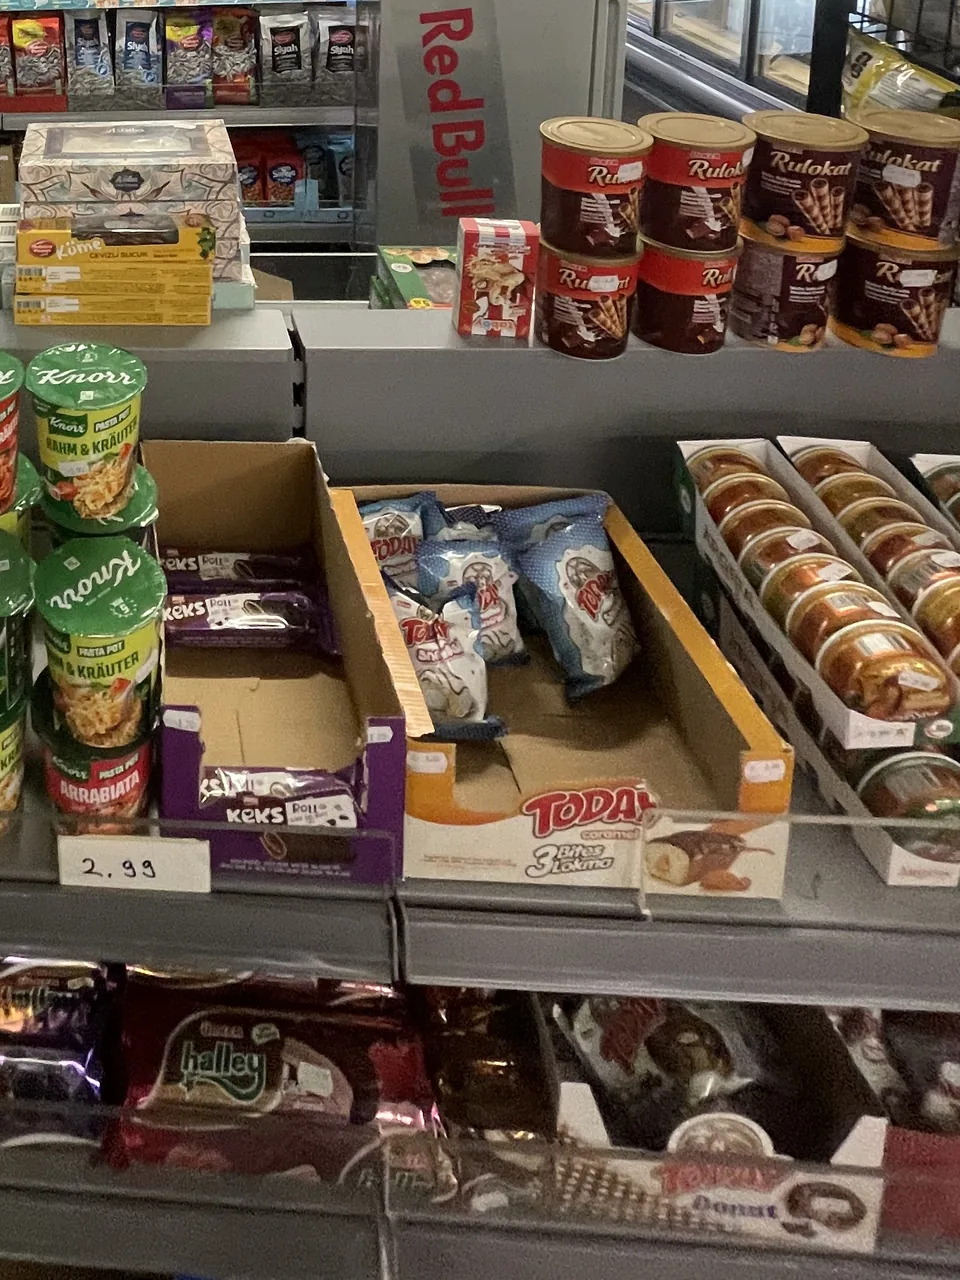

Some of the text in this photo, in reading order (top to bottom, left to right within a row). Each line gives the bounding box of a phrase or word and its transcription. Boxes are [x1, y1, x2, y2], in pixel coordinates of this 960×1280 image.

[274, 43, 299, 55] Siyah
[330, 45, 355, 56] Siyah
[419, 7, 496, 217] Red Bull
[688, 159, 745, 181] Rulok
[769, 150, 853, 176] Rulokat
[559, 268, 631, 291] Ruat
[30, 368, 138, 387] Knorr
[49, 416, 86, 434] Knorr
[94, 417, 118, 433] PASTA
[46, 437, 78, 456] RAHM
[80, 443, 90, 456] &
[48, 550, 142, 610] Knorr
[77, 651, 139, 680] KRÄUTER
[59, 768, 140, 805] ARRABIATA
[524, 787, 658, 839] TODAY
[581, 828, 640, 841] caramel
[81, 857, 157, 879] 2.99
[525, 843, 558, 878] 3
[557, 844, 605, 859] Bites
[552, 856, 615, 874] Lokma
[180, 1040, 266, 1092] halley
